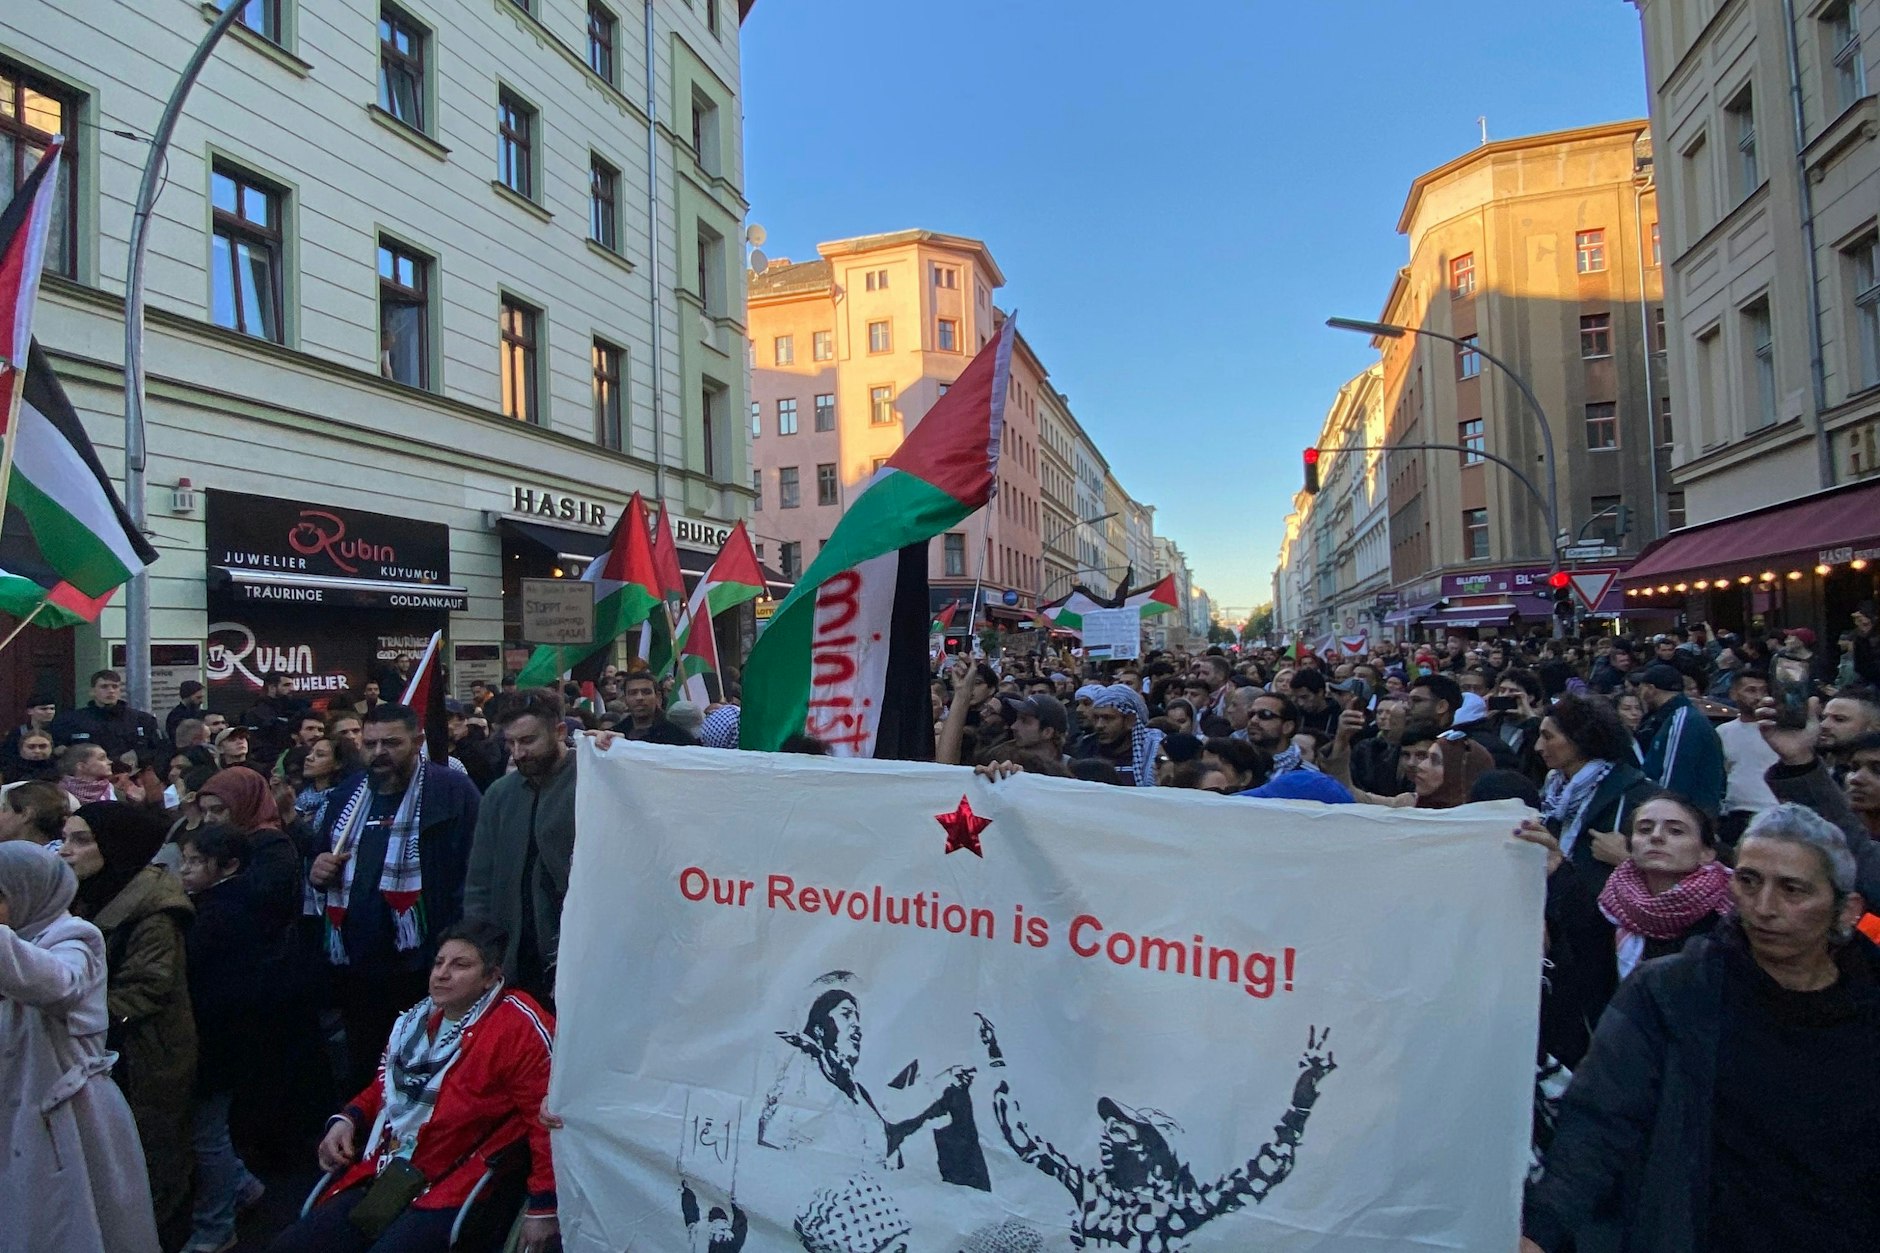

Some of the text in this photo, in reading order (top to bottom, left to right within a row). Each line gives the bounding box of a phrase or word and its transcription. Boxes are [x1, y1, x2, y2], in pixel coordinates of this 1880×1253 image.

[514, 487, 727, 545] HASIR BURG
[224, 551, 438, 580] JUWELIER KUYUMCU
[244, 585, 463, 609] TRAURINGE GOLDANKAUF
[292, 674, 349, 692] UWELIER
[680, 867, 1296, 999] Our Revolution is Coming!
